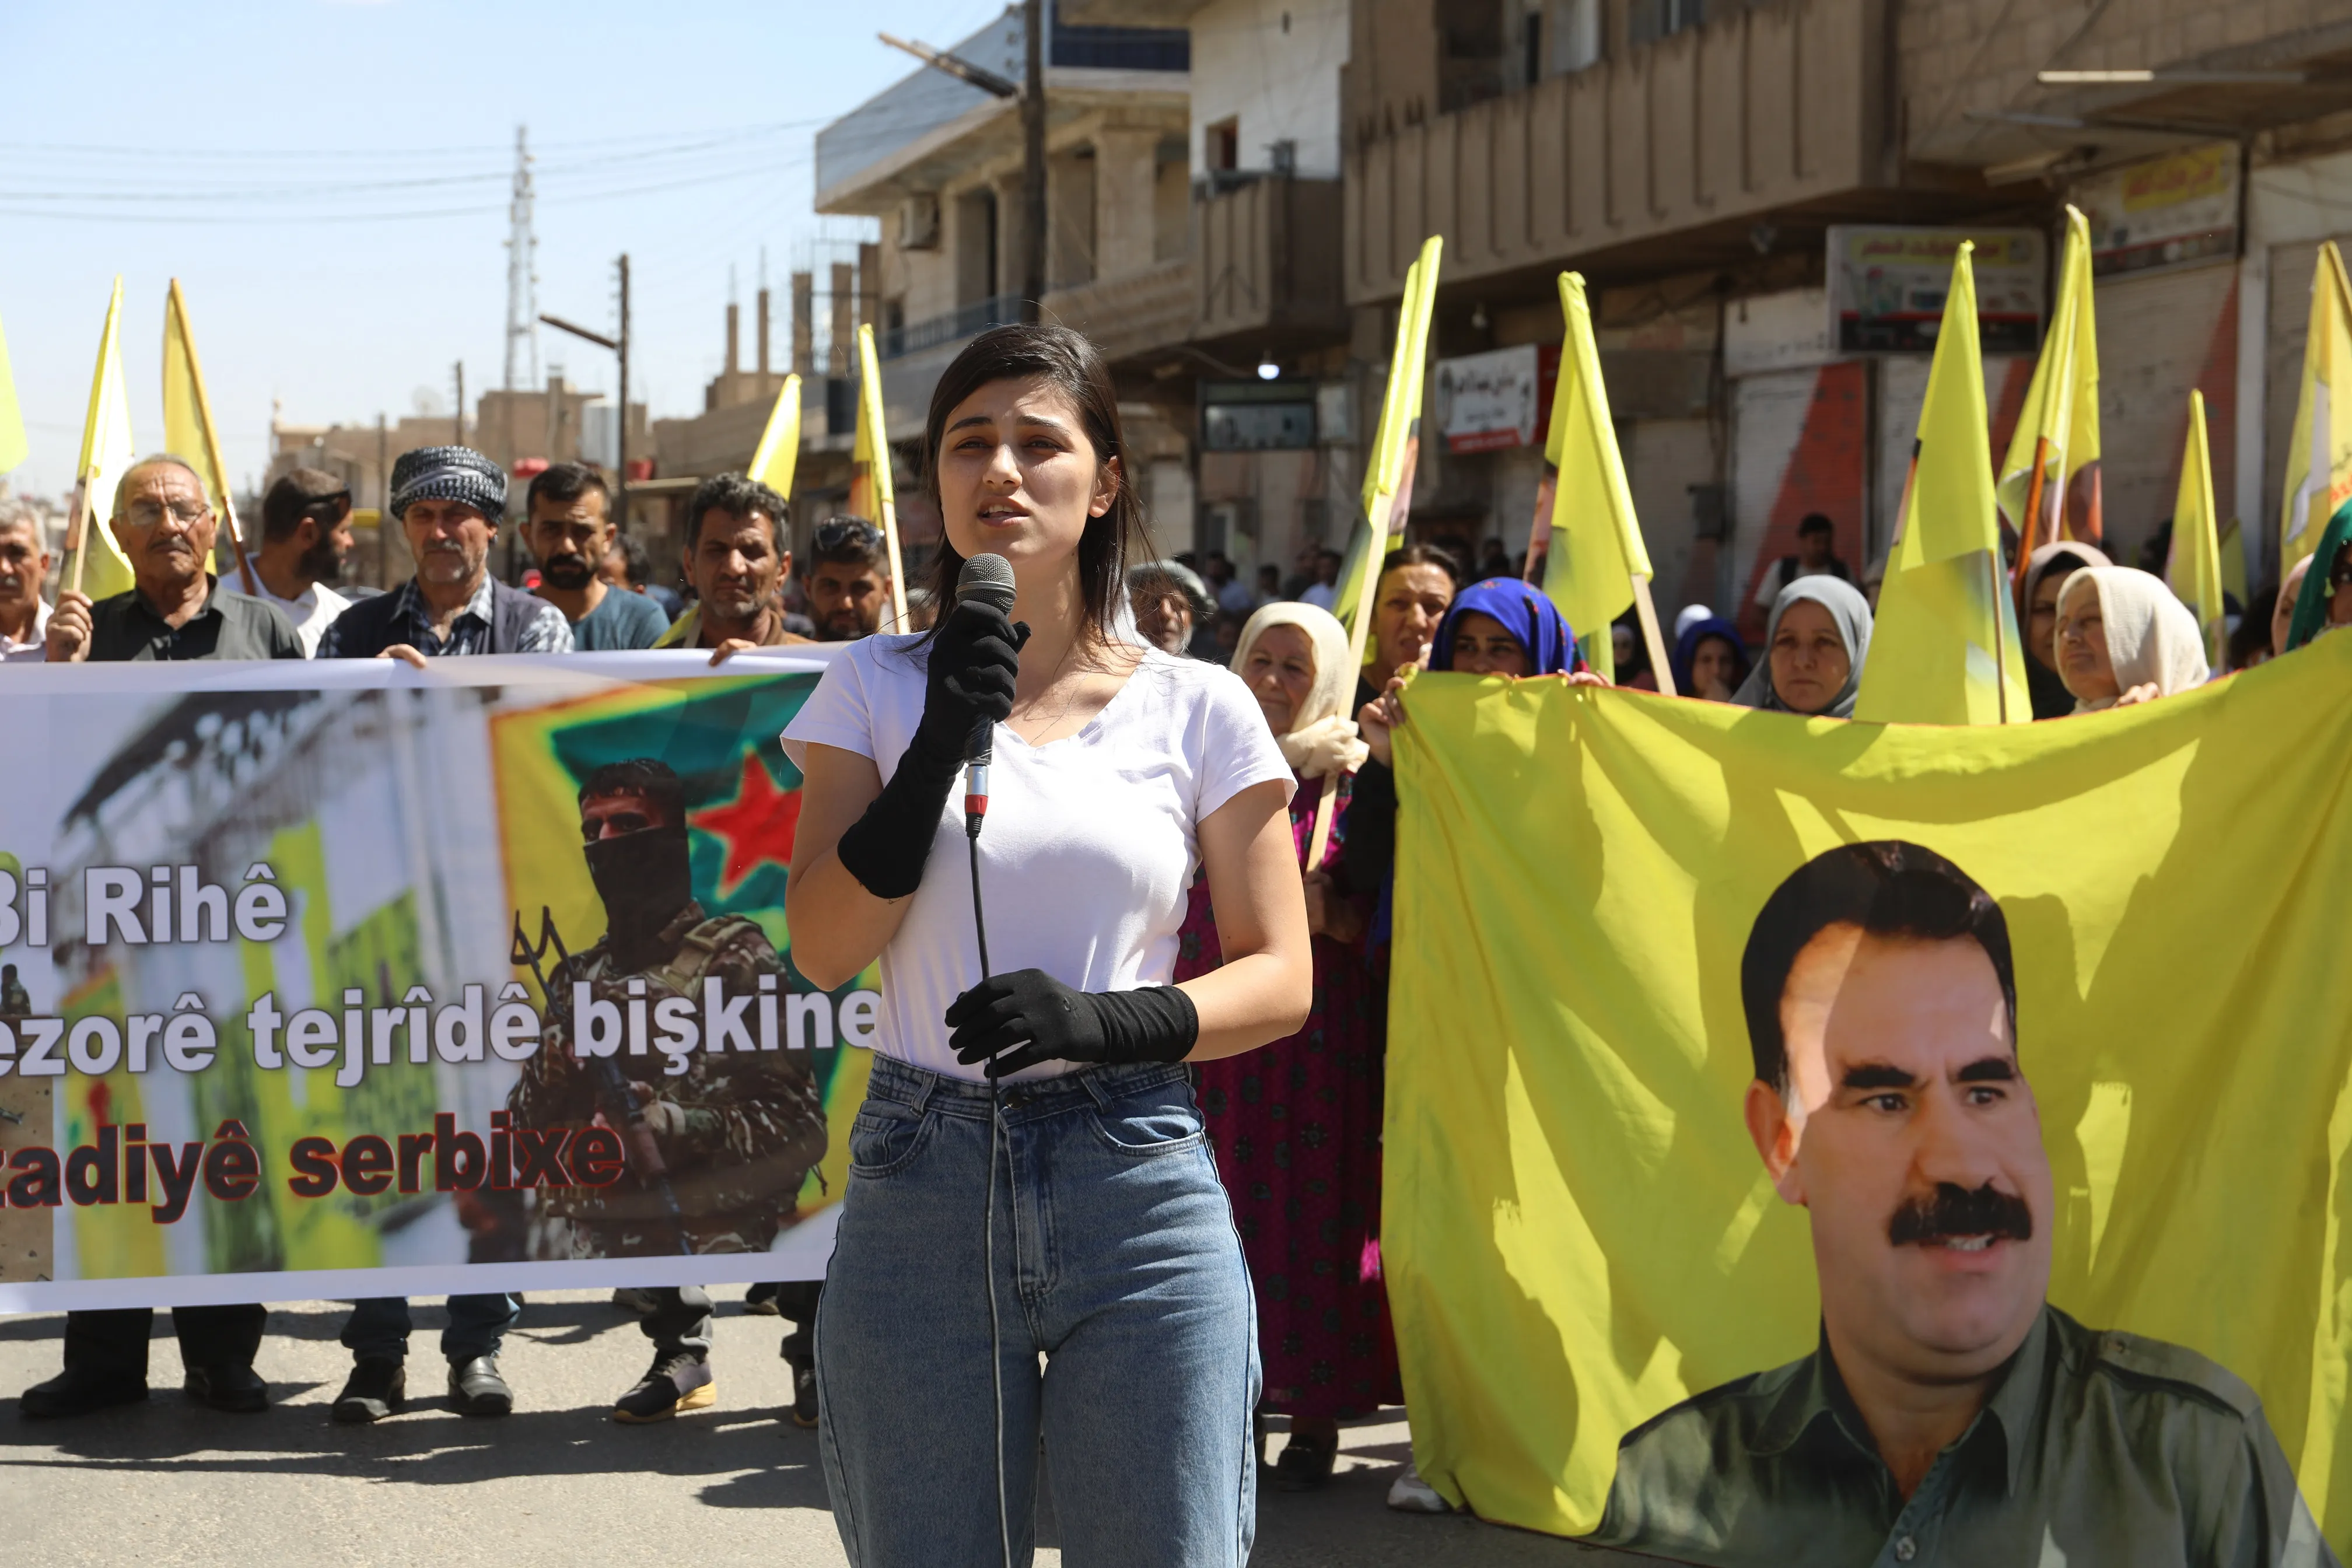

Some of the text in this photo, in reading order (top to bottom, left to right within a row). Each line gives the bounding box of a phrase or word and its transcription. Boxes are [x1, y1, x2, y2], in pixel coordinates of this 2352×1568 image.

[85, 862, 288, 946] Rihê
[247, 983, 541, 1087] tejrîdê
[572, 974, 883, 1076] bişkine
[0, 1111, 625, 1224] adiyê serbixe
